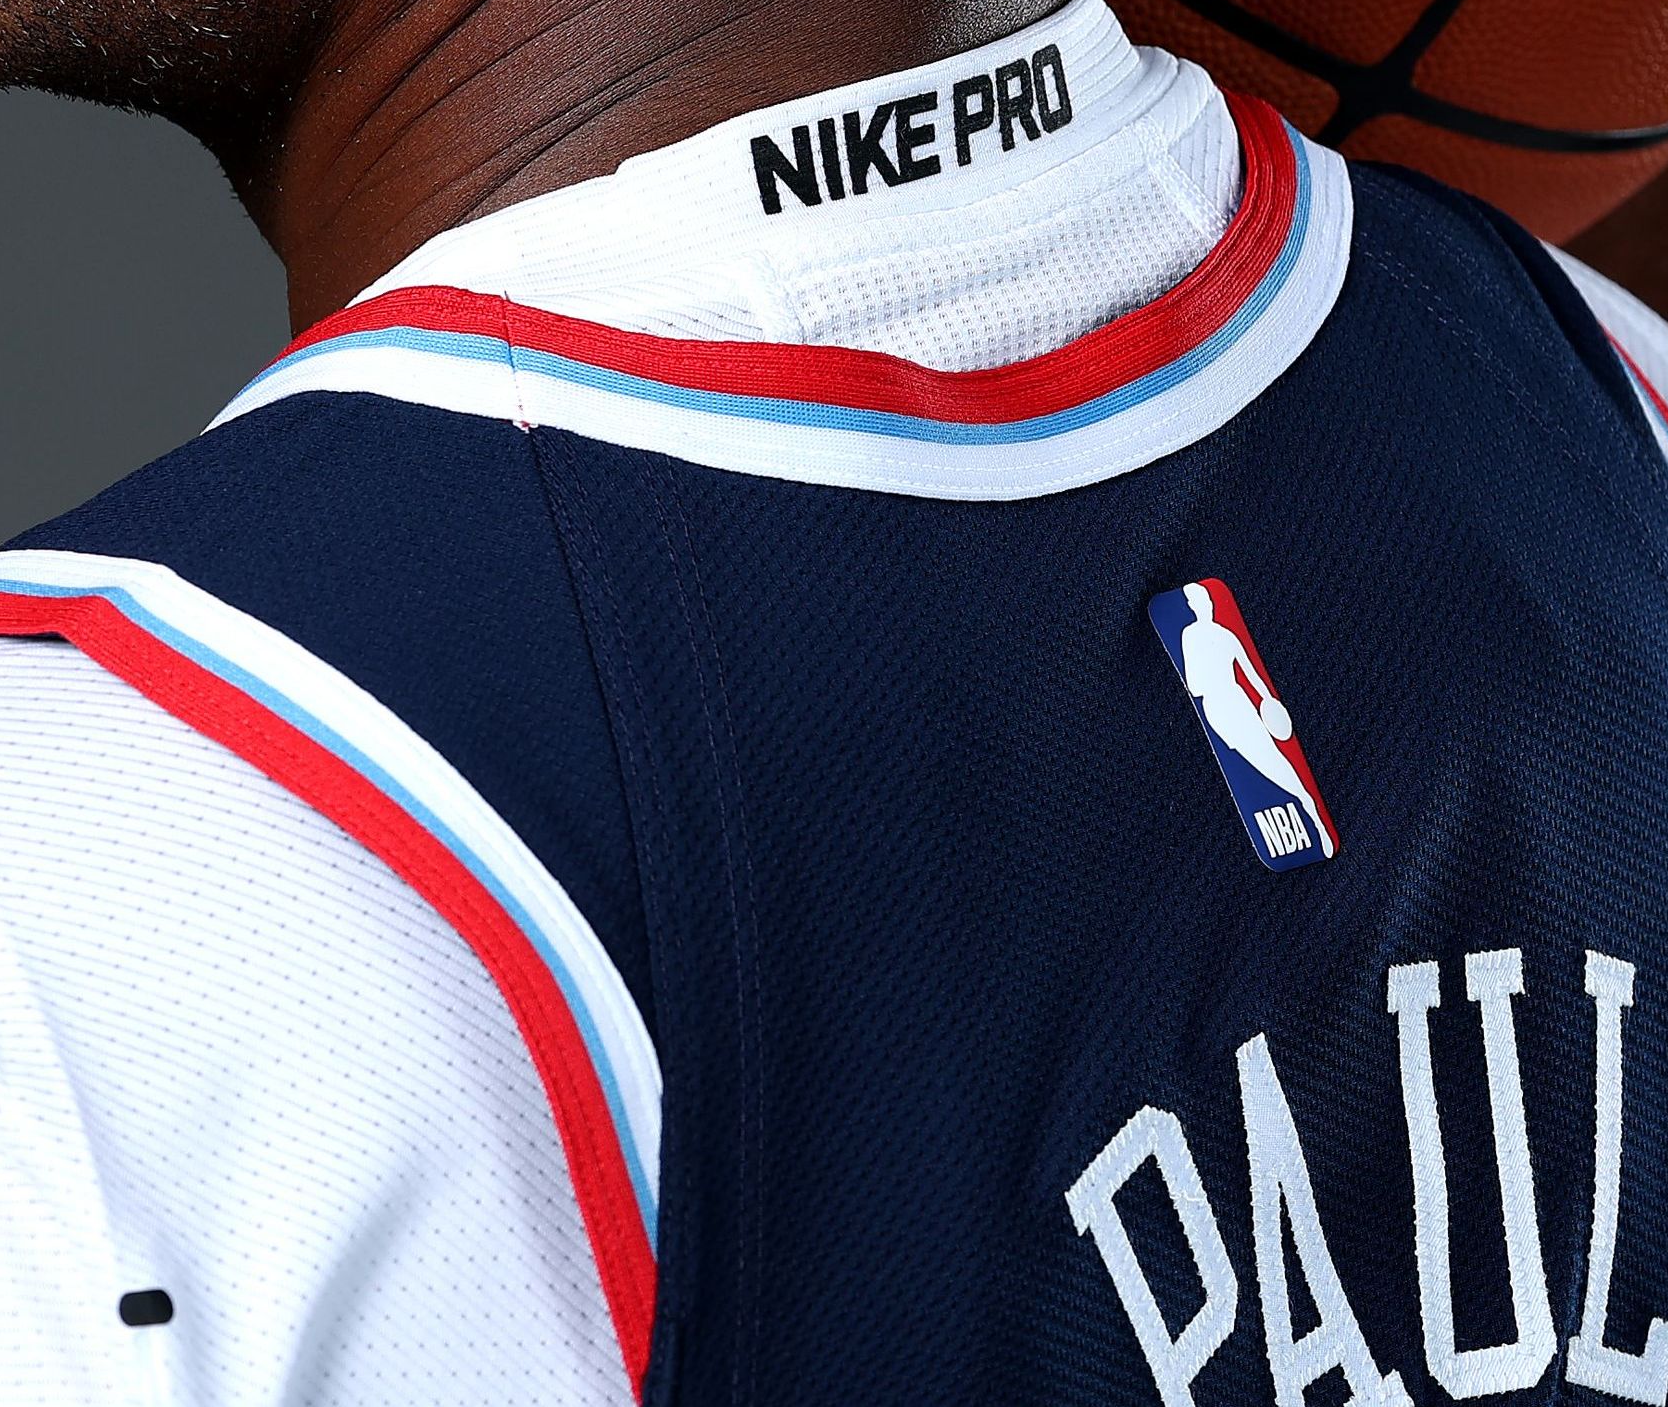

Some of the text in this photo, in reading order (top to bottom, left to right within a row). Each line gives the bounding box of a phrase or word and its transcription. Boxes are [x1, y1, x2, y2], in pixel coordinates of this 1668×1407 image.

[750, 44, 1073, 215] NIKE PRO
[1254, 802, 1312, 858] NBA
